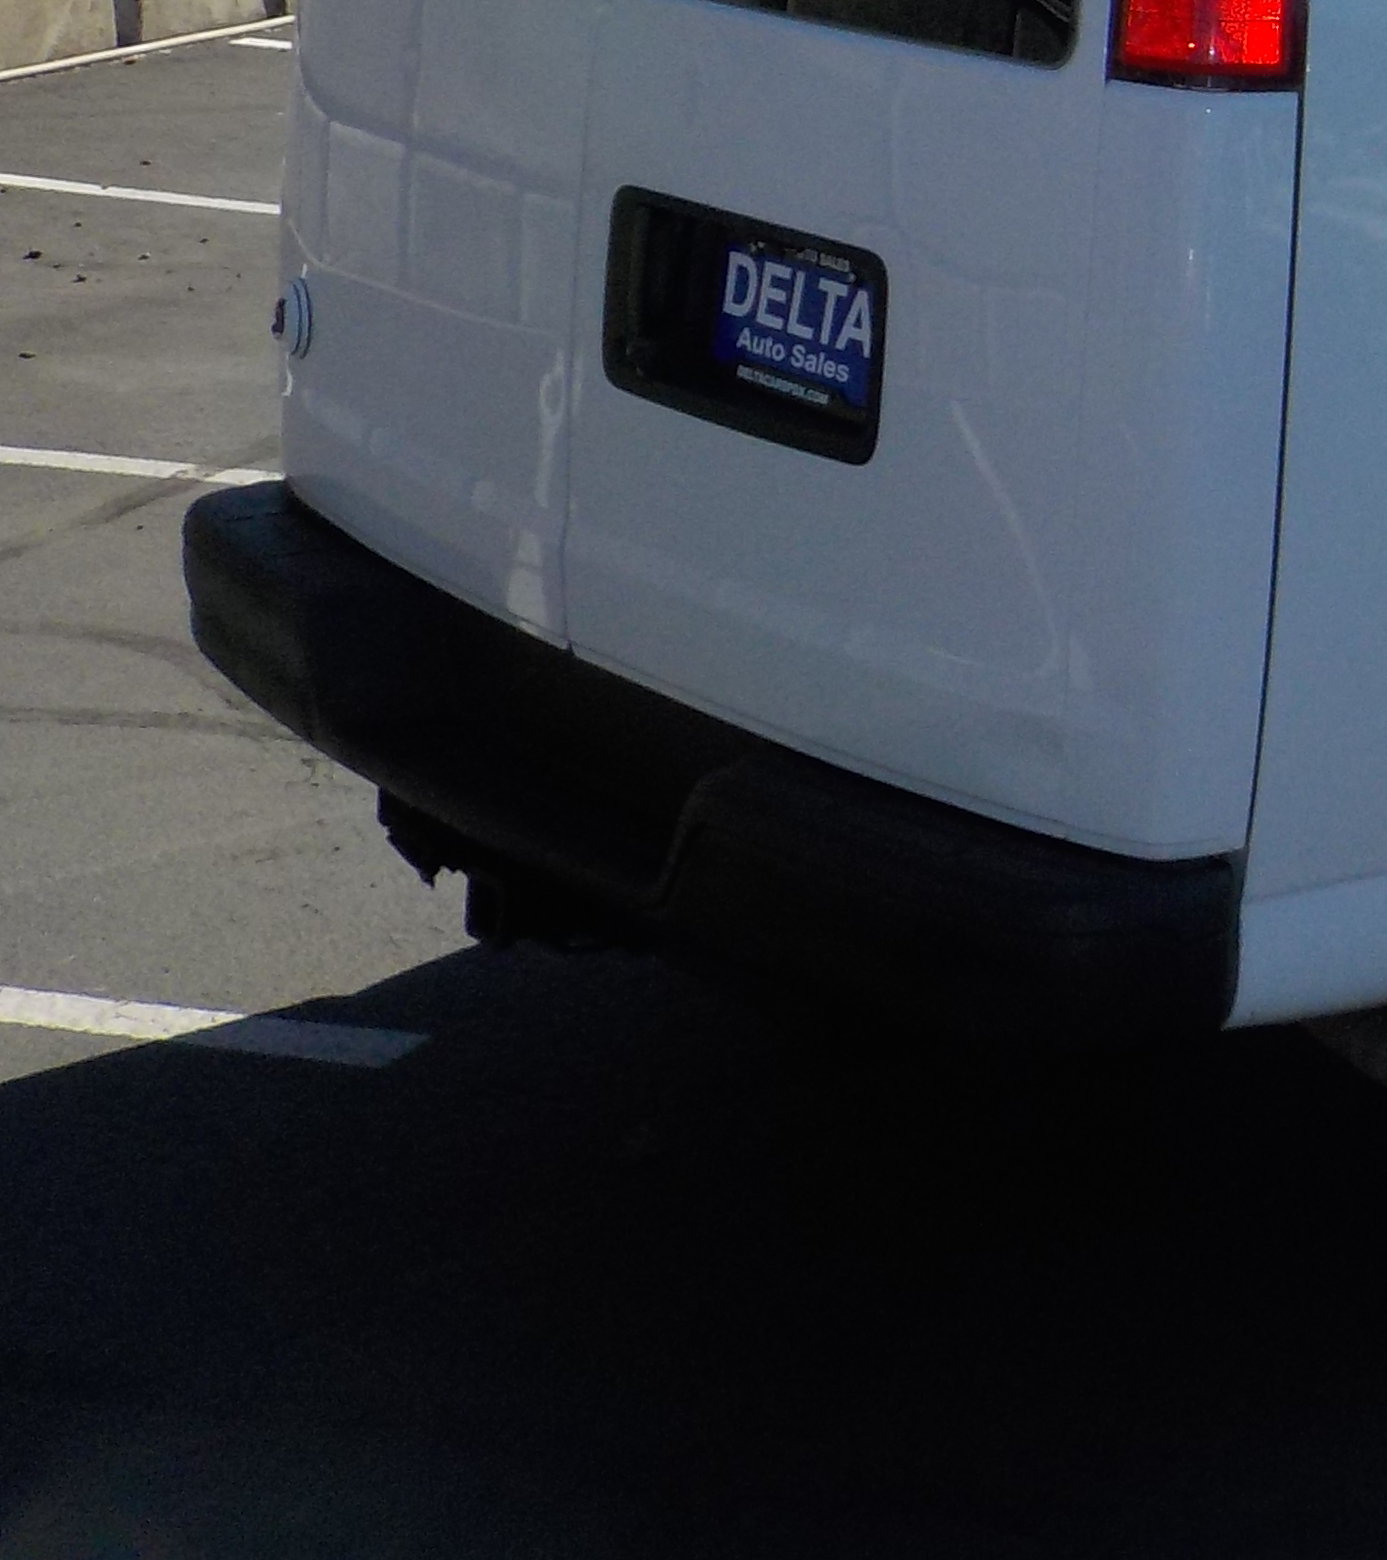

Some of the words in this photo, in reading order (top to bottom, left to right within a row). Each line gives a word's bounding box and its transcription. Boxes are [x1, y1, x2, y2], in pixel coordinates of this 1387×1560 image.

[722, 250, 873, 359] DELTA
[735, 326, 786, 362] Auto
[790, 343, 850, 383] Sales
